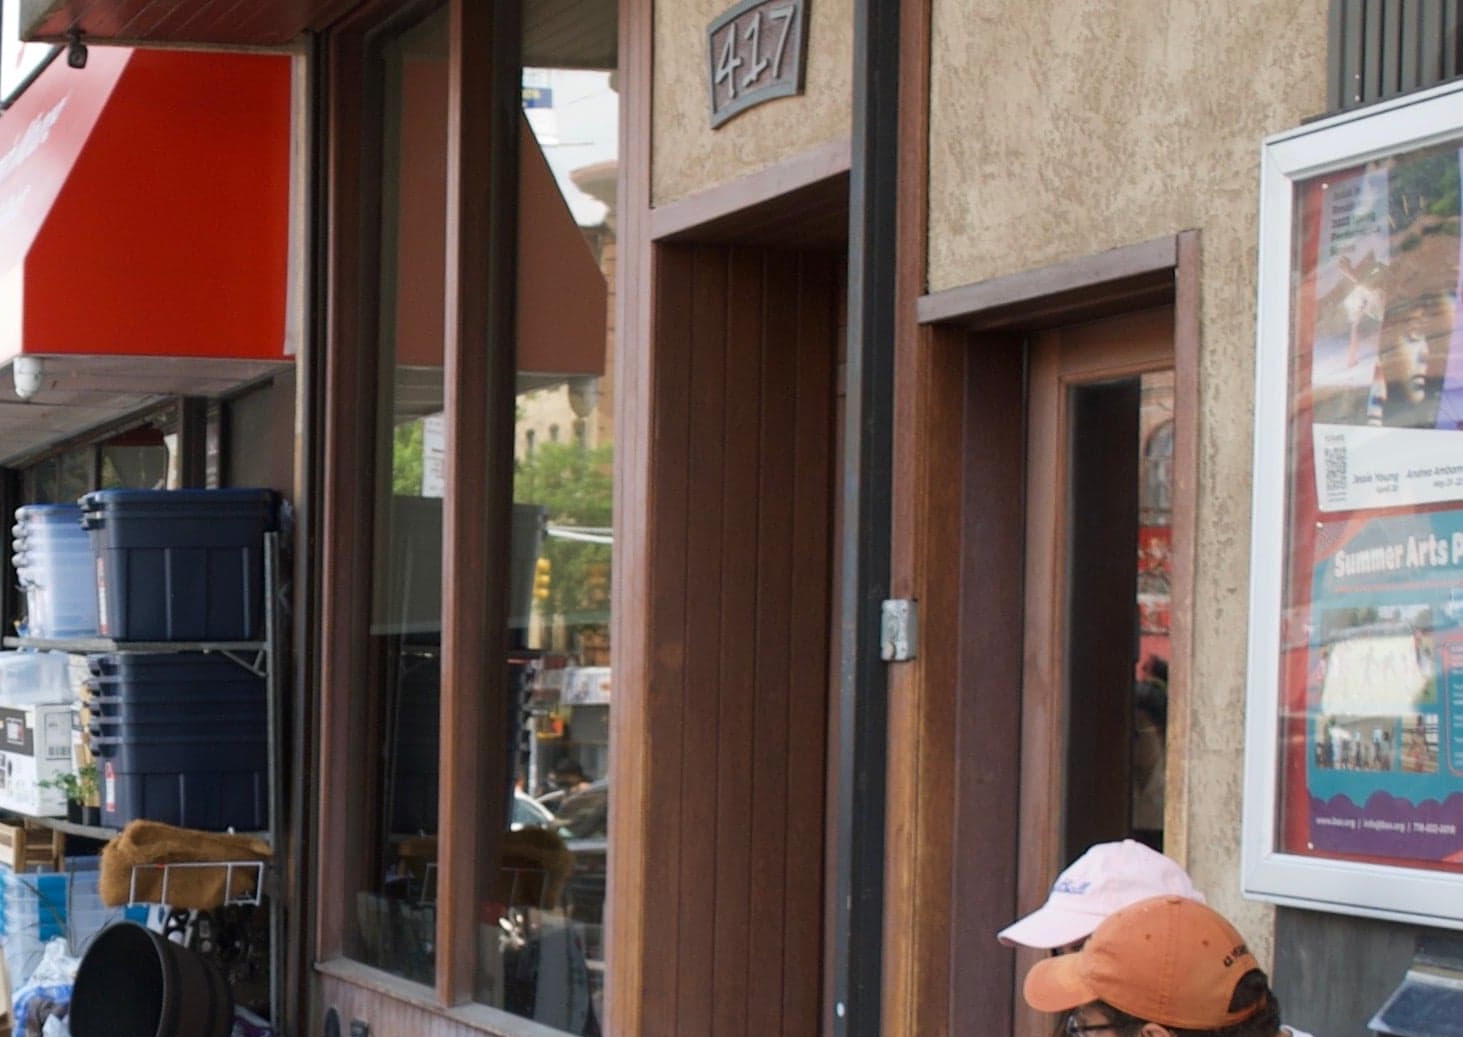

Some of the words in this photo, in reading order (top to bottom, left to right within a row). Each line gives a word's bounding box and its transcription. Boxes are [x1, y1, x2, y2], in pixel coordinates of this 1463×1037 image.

[714, 5, 795, 98] 417
[1334, 544, 1403, 578] Summer
[1406, 533, 1449, 569] Arts
[1451, 531, 1463, 566] P
